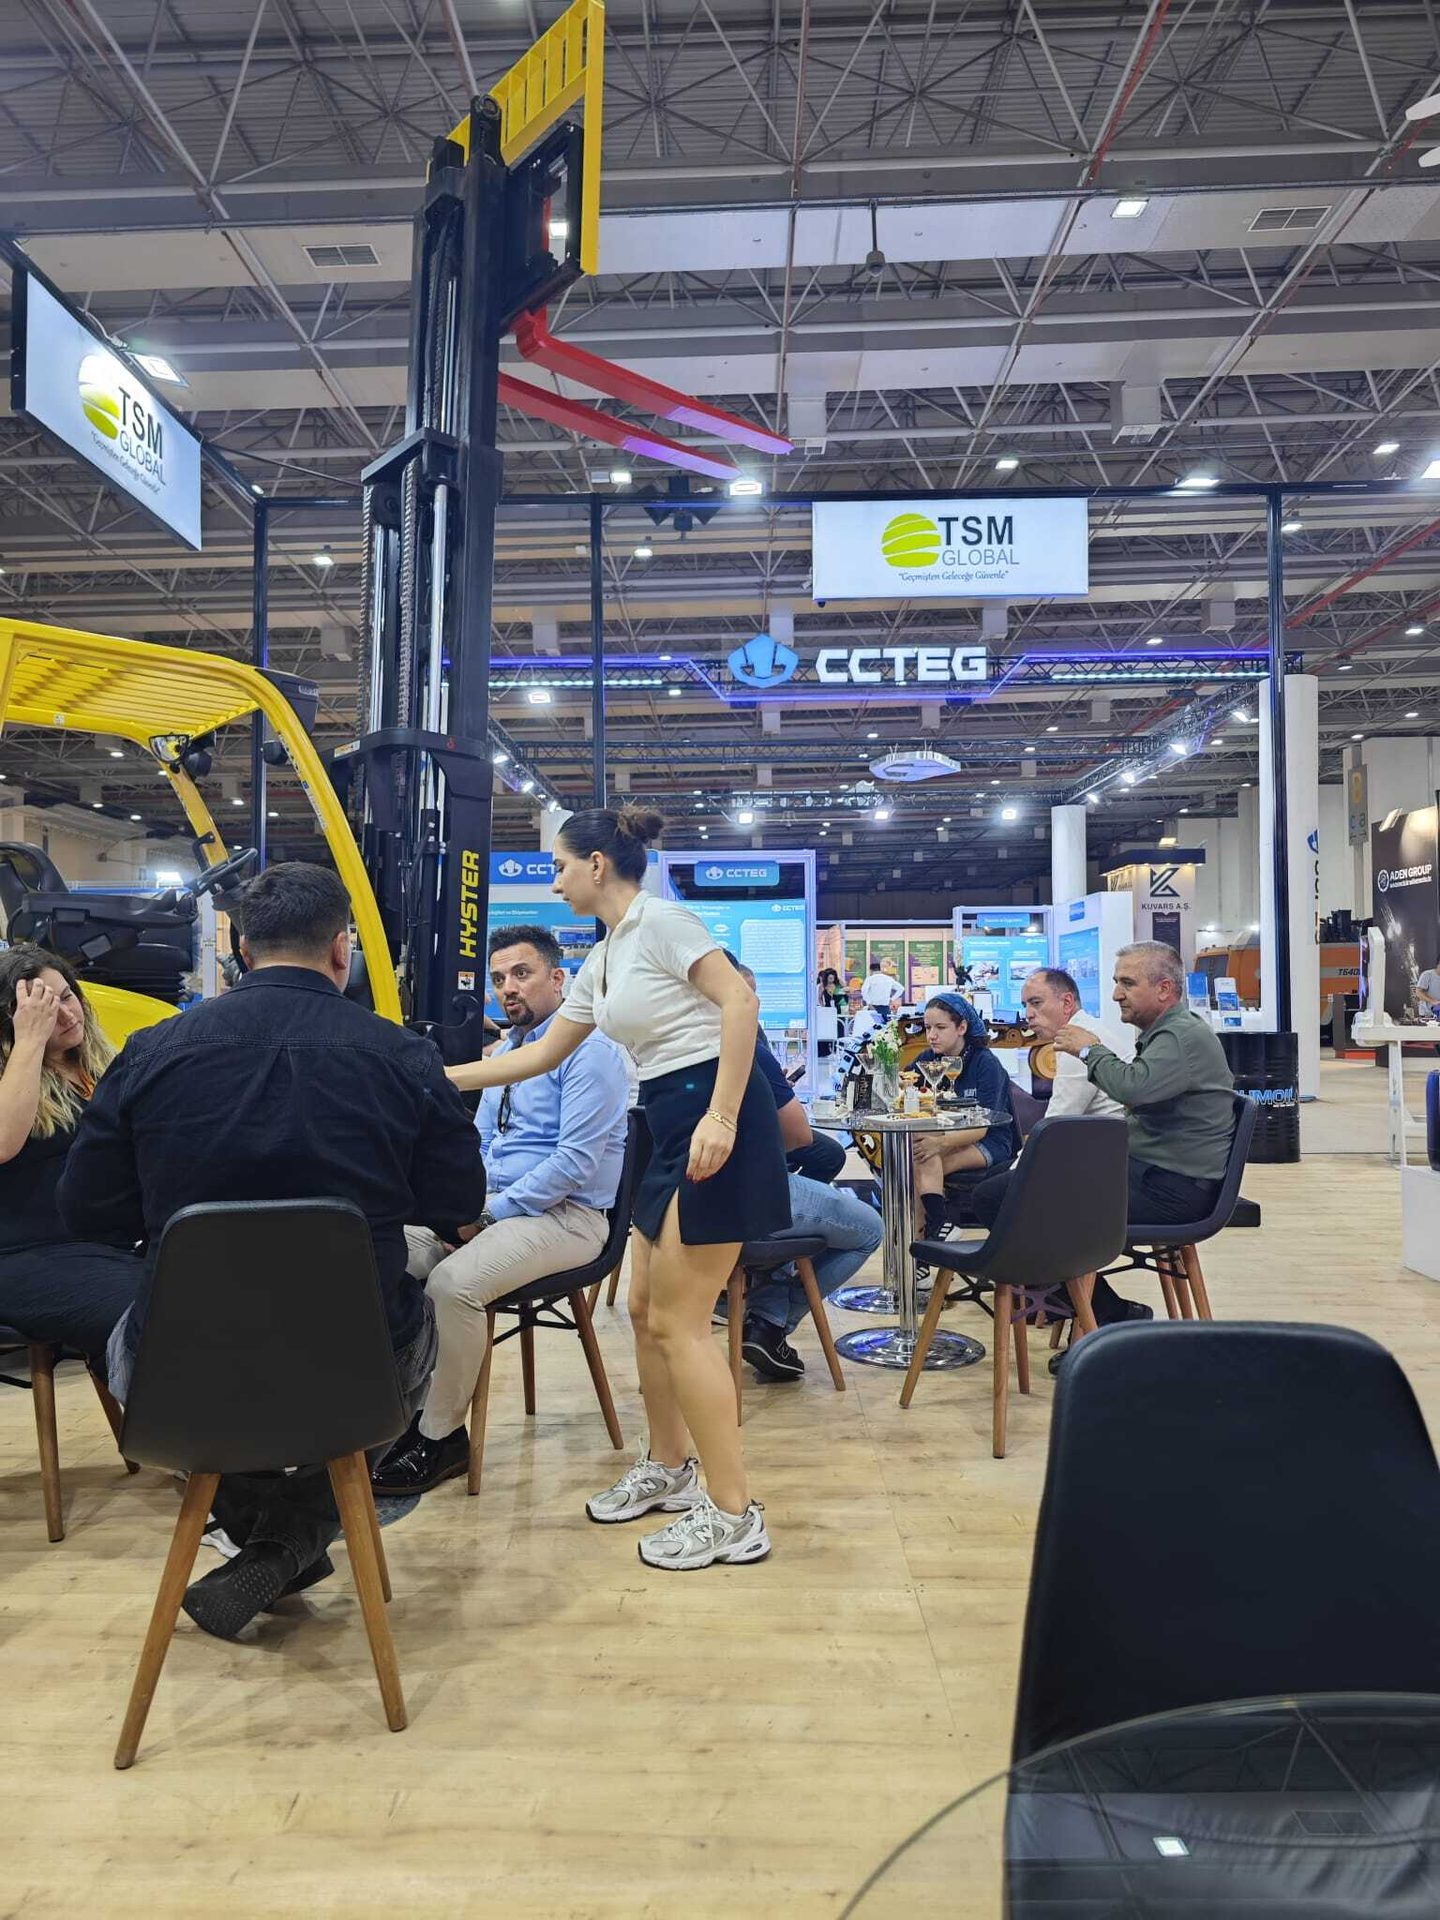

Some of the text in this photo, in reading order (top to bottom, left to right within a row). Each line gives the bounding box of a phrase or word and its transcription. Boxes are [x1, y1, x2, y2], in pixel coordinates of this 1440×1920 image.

[118, 386, 163, 460] TSM
[119, 430, 167, 486] GLOBAL
[937, 515, 1013, 546] TSM
[942, 548, 1020, 566] GLOBAL
[815, 646, 987, 683] CCTEG
[526, 863, 556, 875] CCT
[726, 868, 768, 878] CCTEG
[1390, 864, 1432, 881] ADEN GROUP
[460, 849, 479, 959] HYSTER
[1141, 902, 1174, 911] KUVARS
